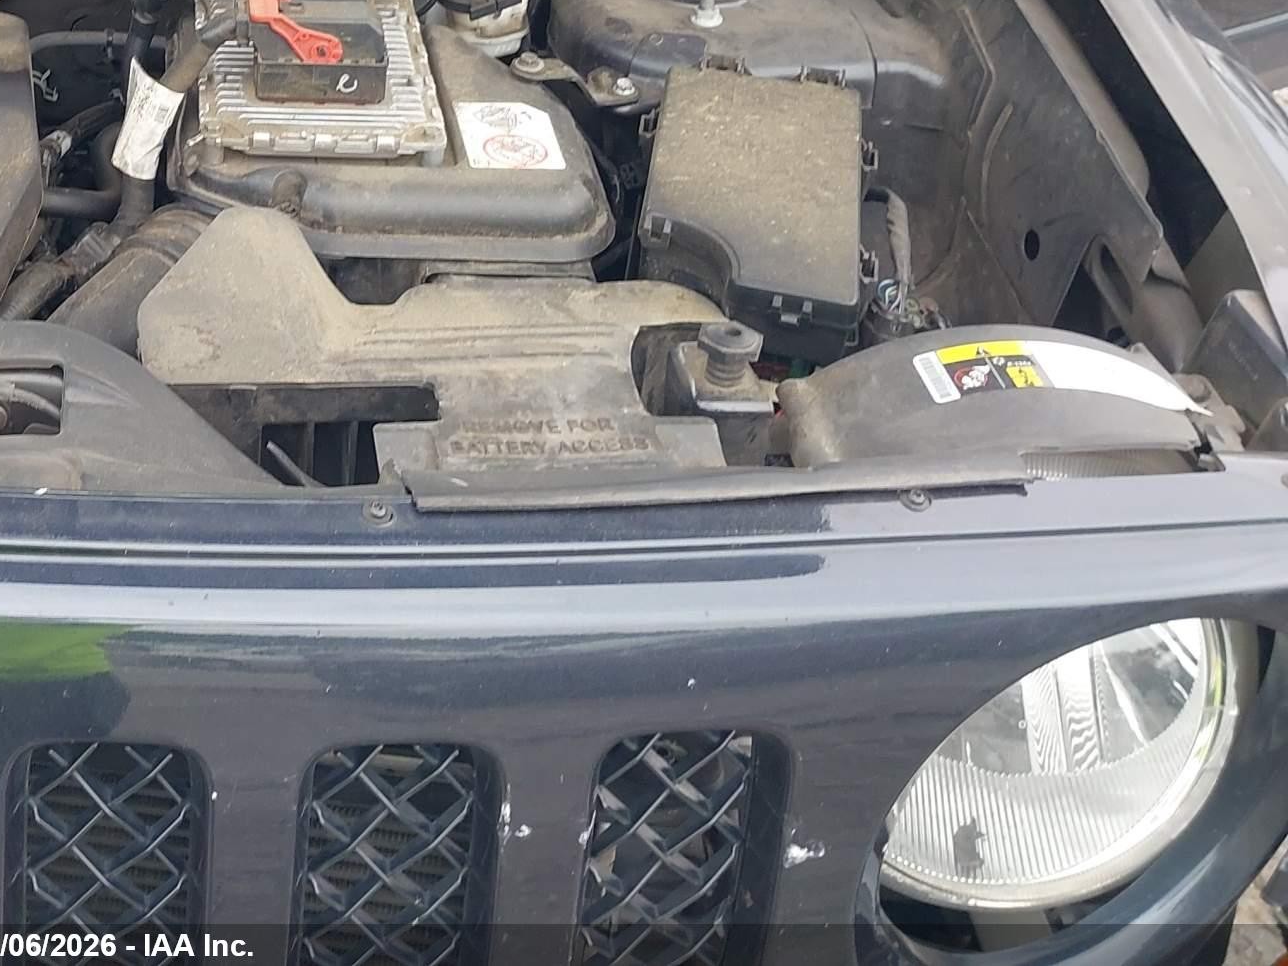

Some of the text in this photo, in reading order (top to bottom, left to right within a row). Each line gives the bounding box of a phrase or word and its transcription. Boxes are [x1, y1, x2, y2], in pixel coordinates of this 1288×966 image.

[462, 417, 615, 435] REMOVE FOR
[449, 436, 650, 456] BATTERY ACCESS
